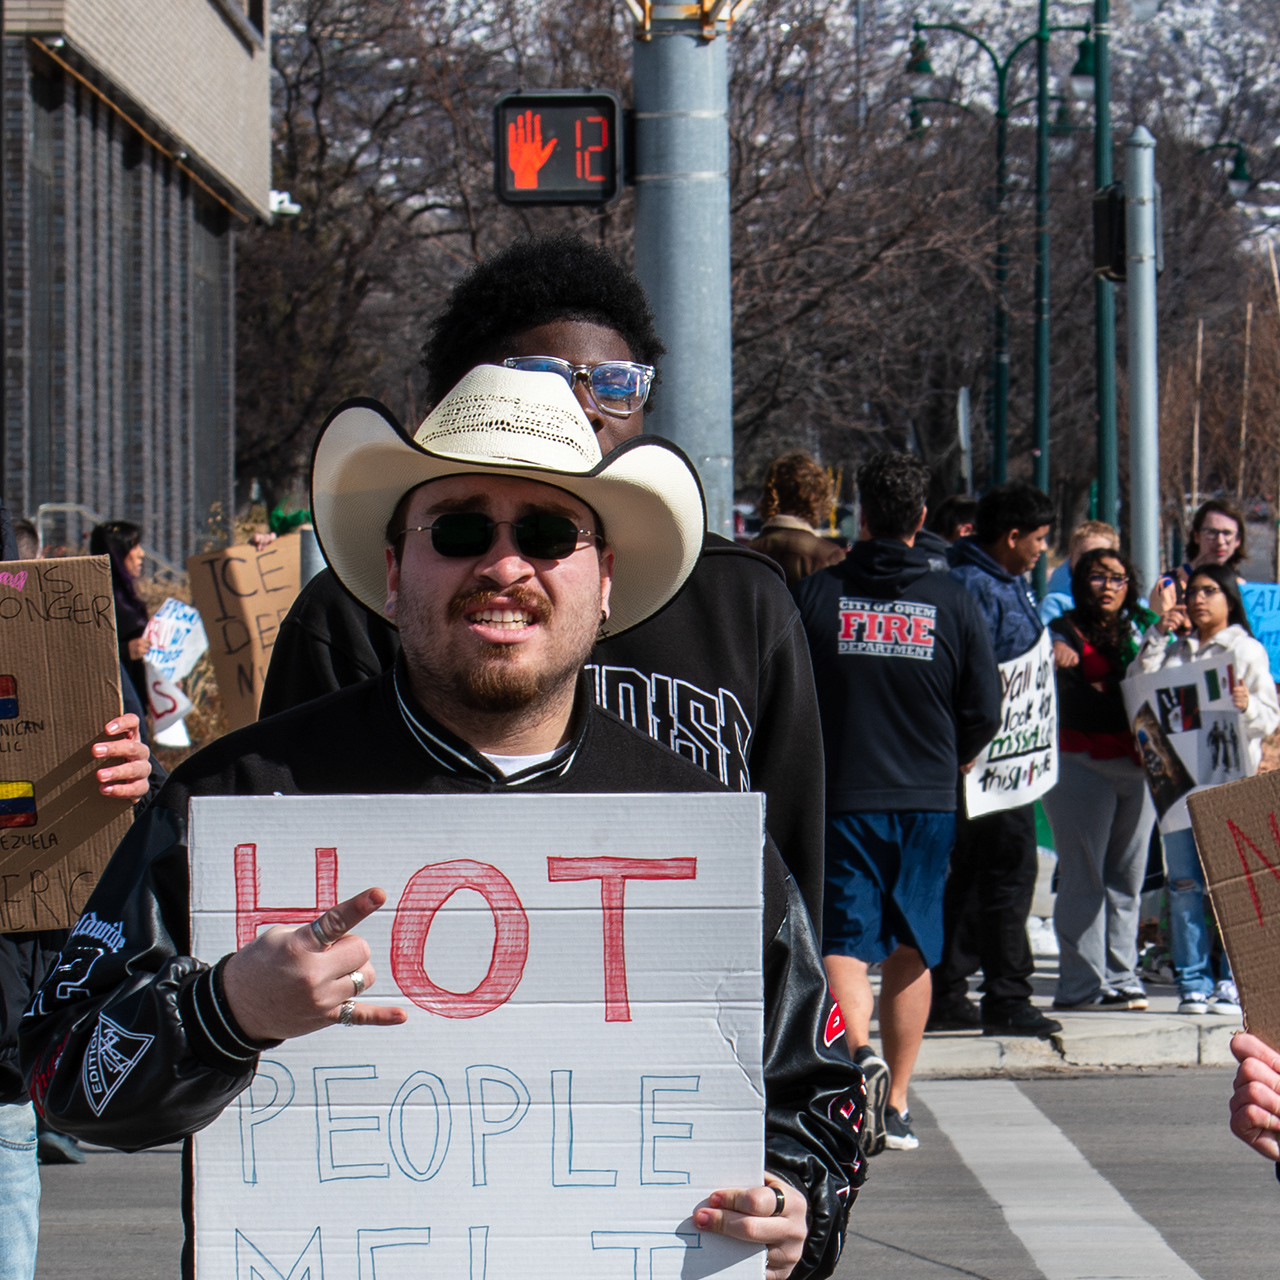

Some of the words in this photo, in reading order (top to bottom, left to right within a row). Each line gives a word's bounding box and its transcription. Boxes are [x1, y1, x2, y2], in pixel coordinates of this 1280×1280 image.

[575, 116, 608, 181] 12
[36, 564, 75, 596] IS
[202, 549, 293, 624] ICE
[838, 610, 937, 648] FIRE
[839, 600, 872, 610] CITY
[894, 604, 937, 618] OREM
[838, 642, 934, 657] DEPARTMENT
[233, 843, 698, 1023] HOT
[237, 1060, 702, 1188] PEOPLE
